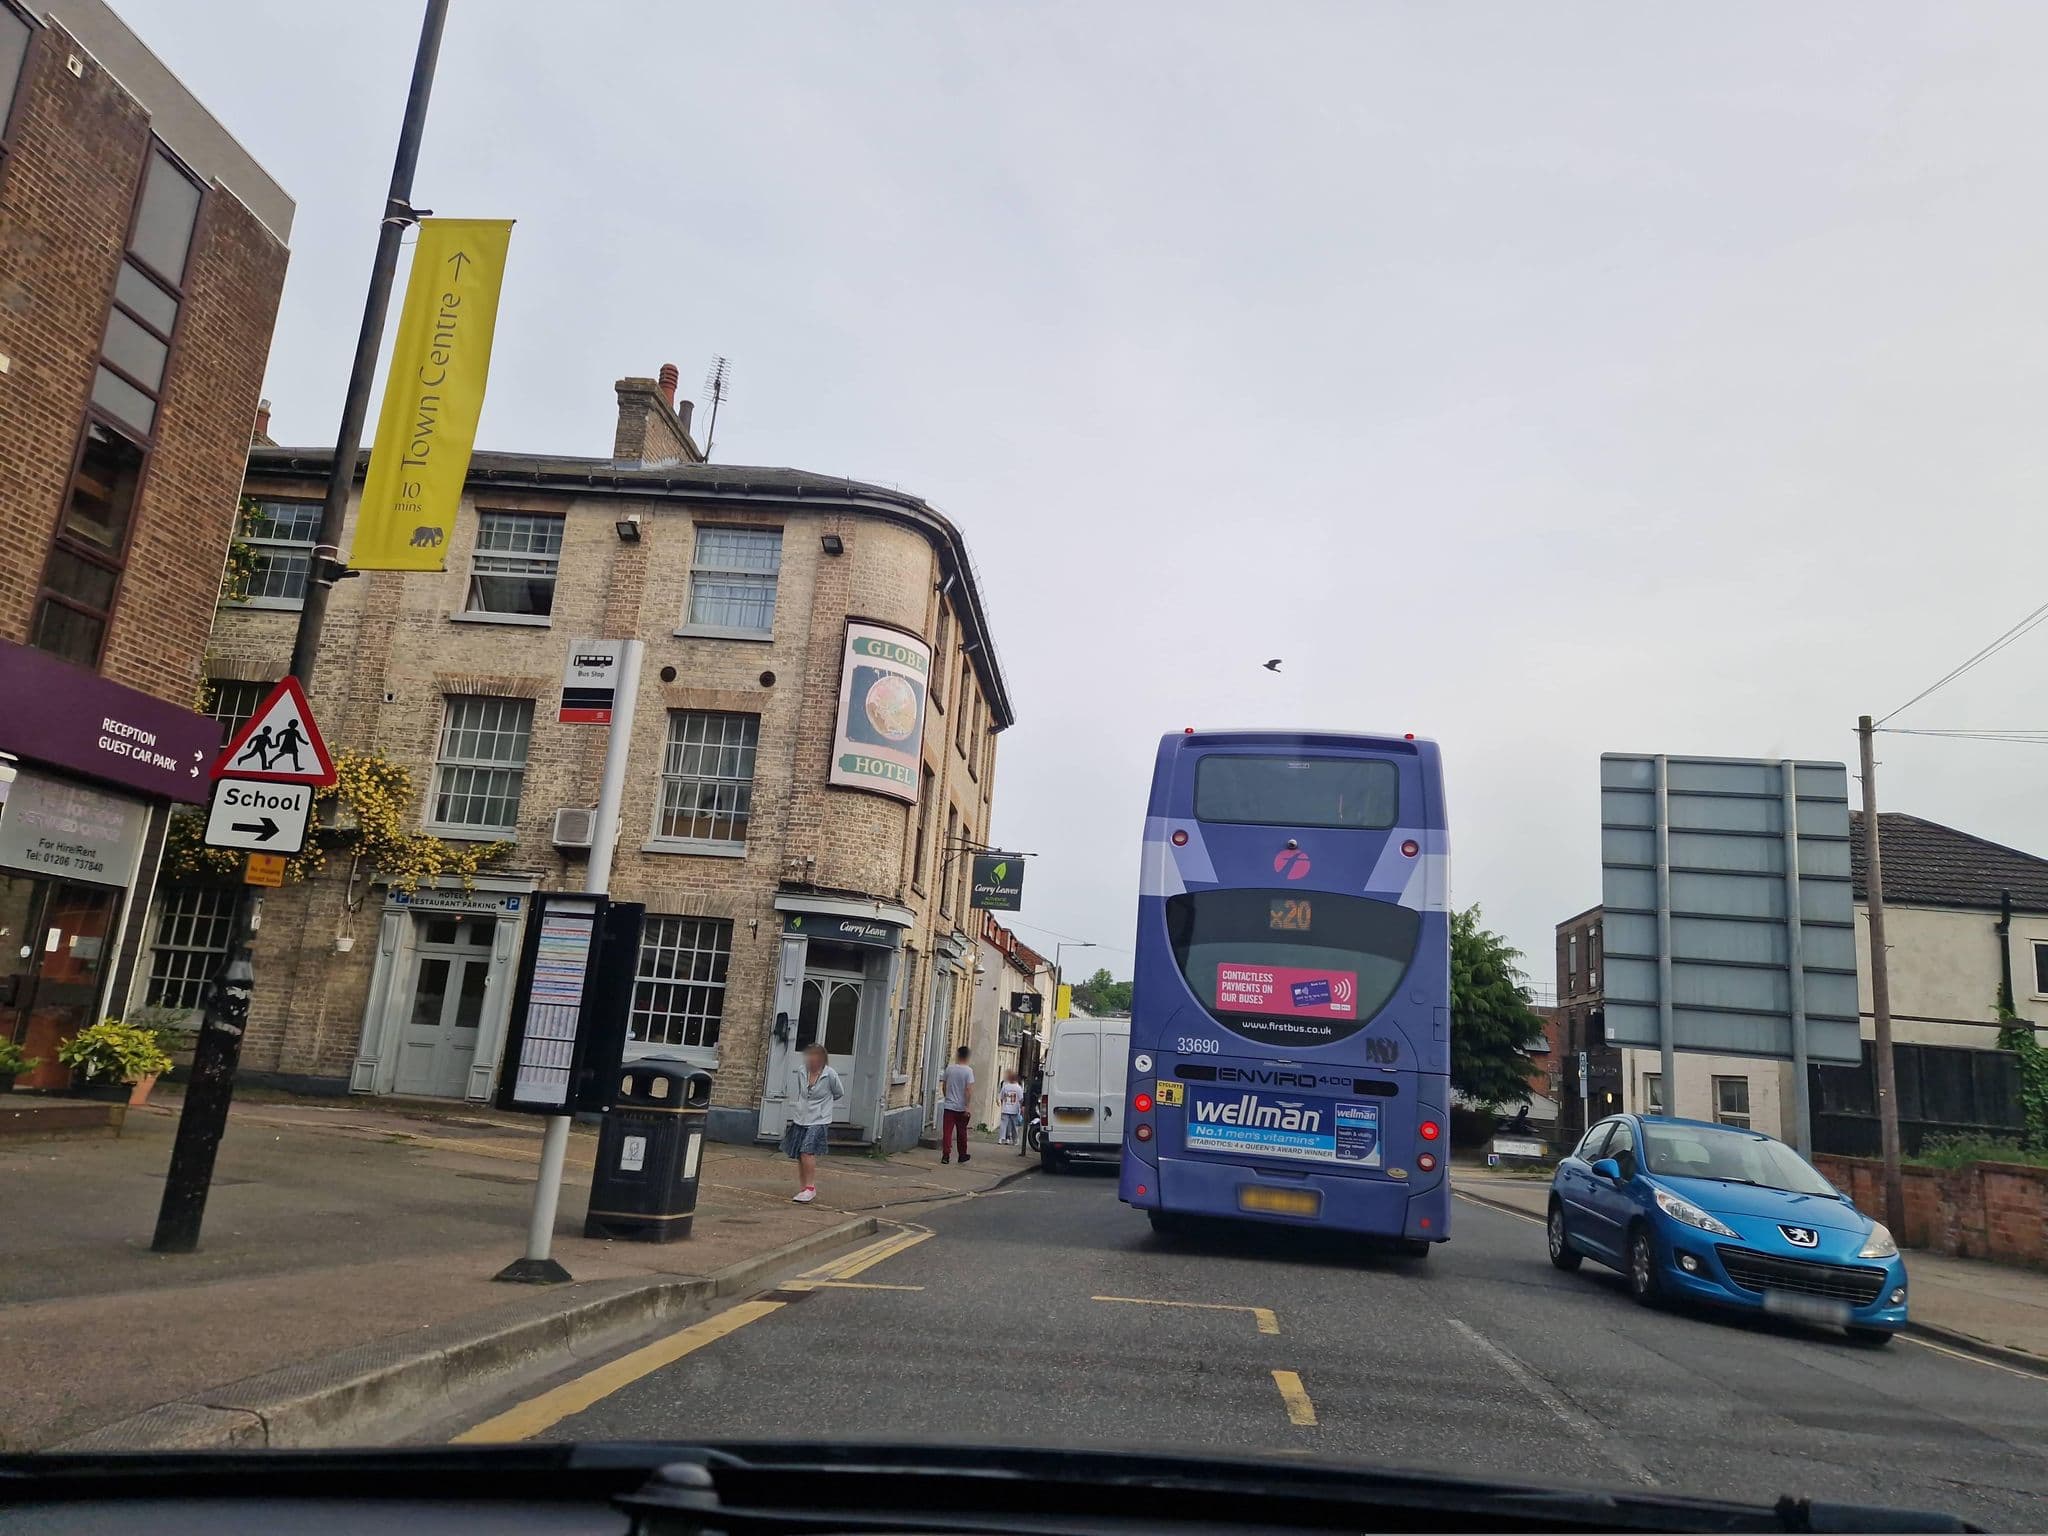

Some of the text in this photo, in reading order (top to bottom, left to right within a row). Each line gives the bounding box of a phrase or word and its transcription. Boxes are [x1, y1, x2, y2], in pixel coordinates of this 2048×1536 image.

[401, 292, 461, 471] Town Centre
[402, 482, 421, 499] 10
[394, 502, 422, 513] mins
[867, 640, 924, 671] GLOBE
[102, 717, 156, 747] RECEPTION
[98, 736, 178, 772] GUEST CAR PARK
[854, 757, 911, 785] HOTEL
[223, 788, 300, 811] School
[38, 838, 55, 850] For
[26, 849, 41, 861] Tel:
[43, 853, 70, 867] 01206
[438, 890, 464, 899] HOTEL
[974, 883, 1019, 896] Curry Leaves
[410, 897, 497, 910] RESTAURANT PARKING
[840, 921, 887, 937] Curry Leaves
[1222, 970, 1273, 983] CONTACTLESS
[1222, 981, 1273, 994] PAYMENTS ON
[1221, 993, 1264, 1005] OUR BUSES
[1242, 1020, 1332, 1036] www.firstbus.co.uk
[1177, 1037, 1219, 1054] 33690
[1218, 1067, 1351, 1089] ENVIRO 400
[1196, 1125, 1223, 1137] No.1
[1225, 1130, 1260, 1141] men's
[1245, 1142, 1276, 1152] QUEEN'S
[1277, 1145, 1304, 1155] AWARD
[1304, 1148, 1334, 1158] WINNER
